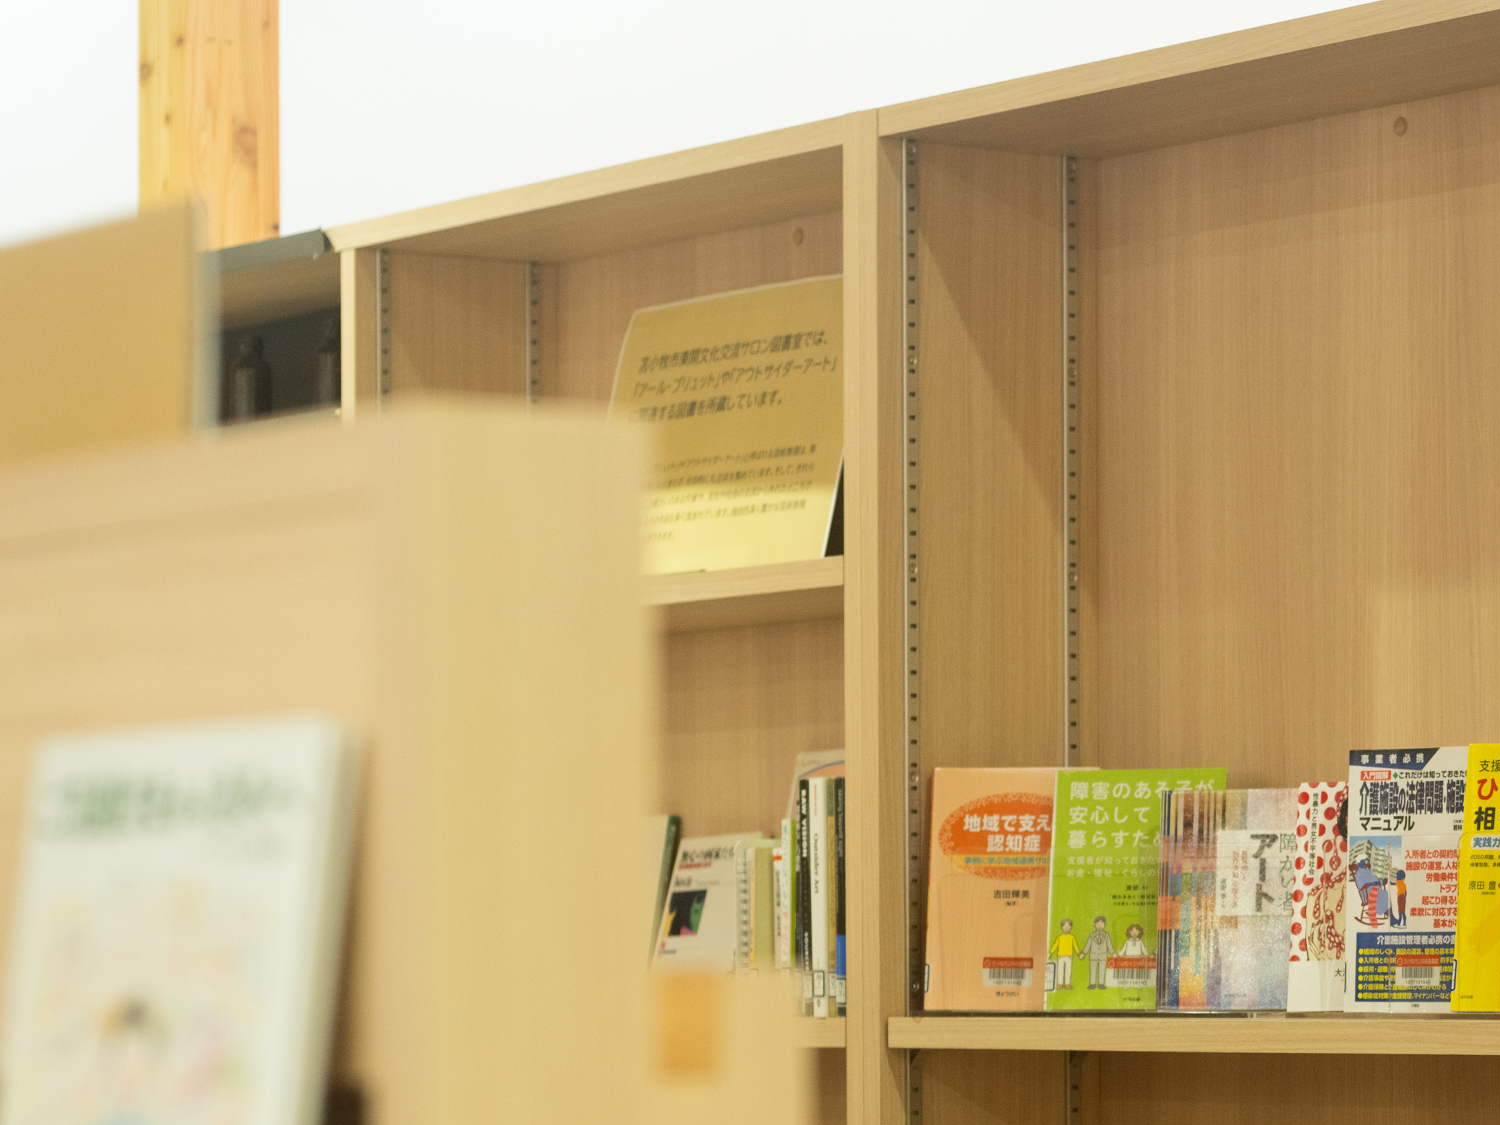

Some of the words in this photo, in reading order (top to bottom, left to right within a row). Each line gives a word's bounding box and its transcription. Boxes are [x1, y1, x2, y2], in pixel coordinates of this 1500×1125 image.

[1361, 753, 1425, 765] 事業者必携
[1359, 780, 1465, 815] 介護施設の法律問題・施設
[963, 814, 1052, 832] 地域で支え
[1069, 806, 1150, 825] 安心して
[1359, 816, 1415, 832] マニュアル
[987, 834, 1041, 852] 認知症
[1308, 792, 1320, 876] 性暴力と男女不平等社会
[1468, 880, 1485, 890] 原田
